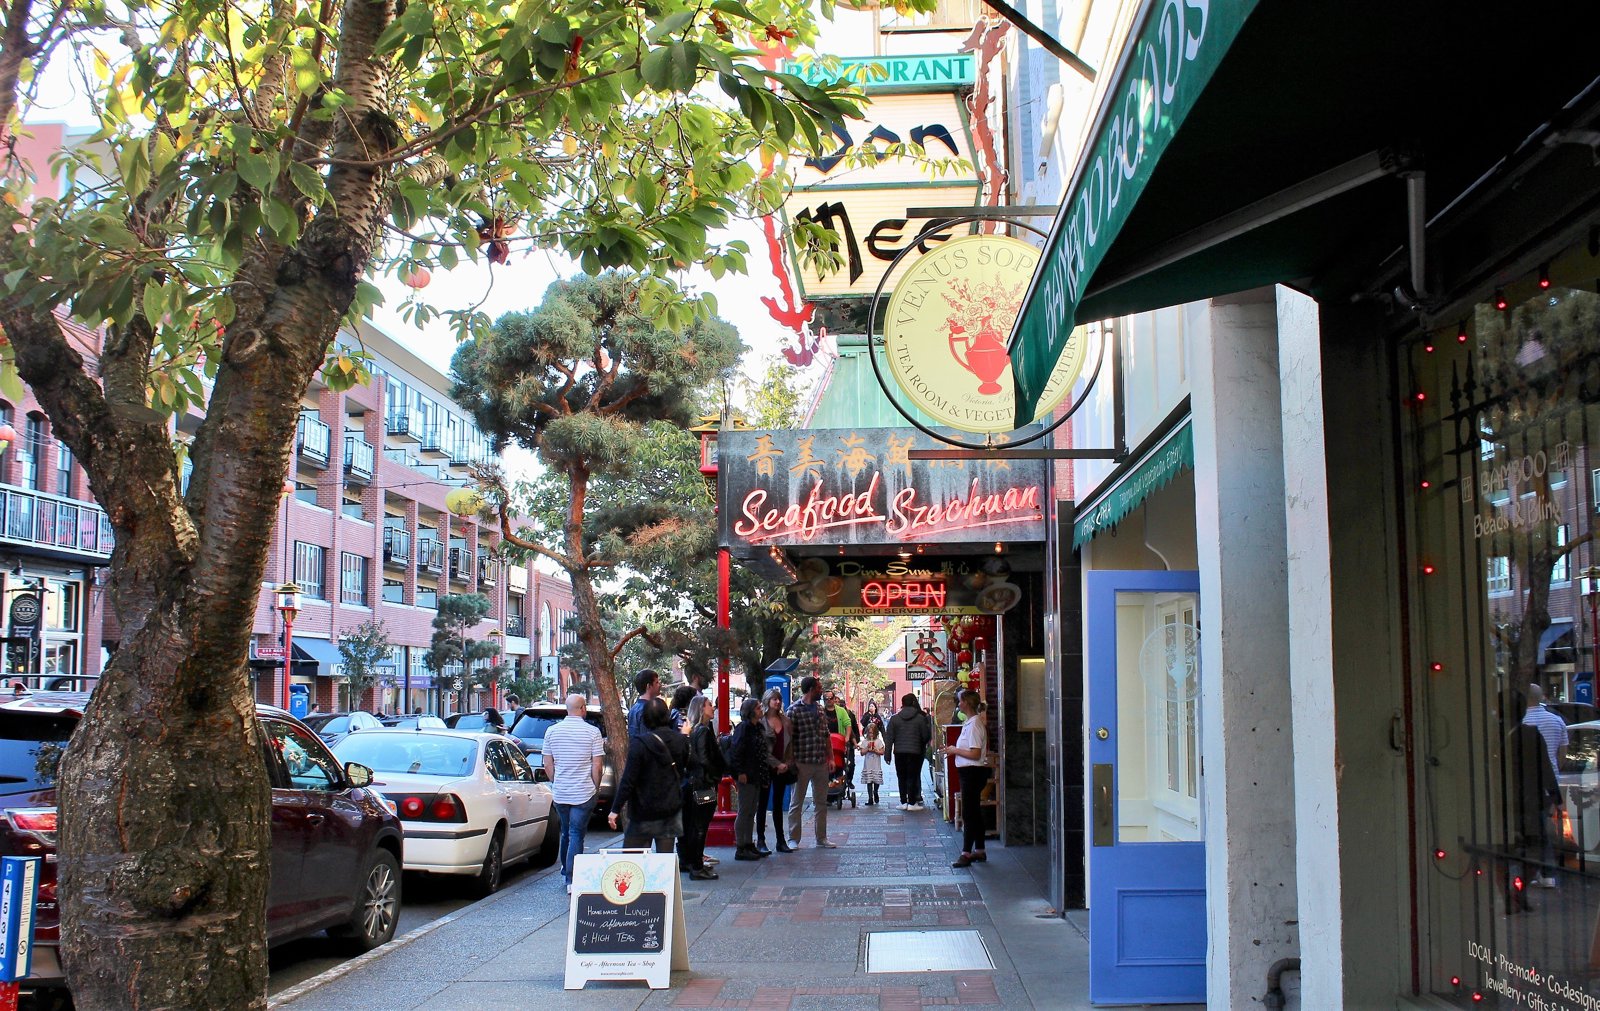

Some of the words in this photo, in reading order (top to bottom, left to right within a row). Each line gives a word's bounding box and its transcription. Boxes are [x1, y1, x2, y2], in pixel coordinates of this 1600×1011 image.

[1043, 155, 1105, 353] BAMBOO
[896, 248, 969, 331] VENUS
[896, 343, 916, 377] TEA
[909, 374, 948, 412] ROOM
[948, 404, 962, 418] &
[1480, 450, 1547, 496] BAMBOO
[734, 471, 882, 541] Seafood
[885, 477, 1041, 535] Szechuan
[1473, 511, 1510, 539] Beads
[1512, 502, 1525, 529] &
[1527, 495, 1562, 527] Bling
[836, 561, 882, 578] Dim
[885, 561, 934, 577] Sum
[862, 582, 946, 608] OPEN
[842, 607, 881, 615] LUNCH
[884, 607, 930, 615] SERVED
[932, 607, 965, 615] DAILY
[296, 700, 302, 708] P
[6, 863, 13, 877] P
[624, 904, 650, 917] LUNCH
[581, 933, 588, 946] &
[591, 932, 610, 944] HIGH
[616, 931, 636, 943] TEAS
[598, 960, 626, 969] Afternoon
[642, 960, 656, 968] Shop
[1467, 940, 1493, 966] LOCAL
[1499, 953, 1541, 986] Pre-made
[1485, 971, 1522, 1005] Jewellery
